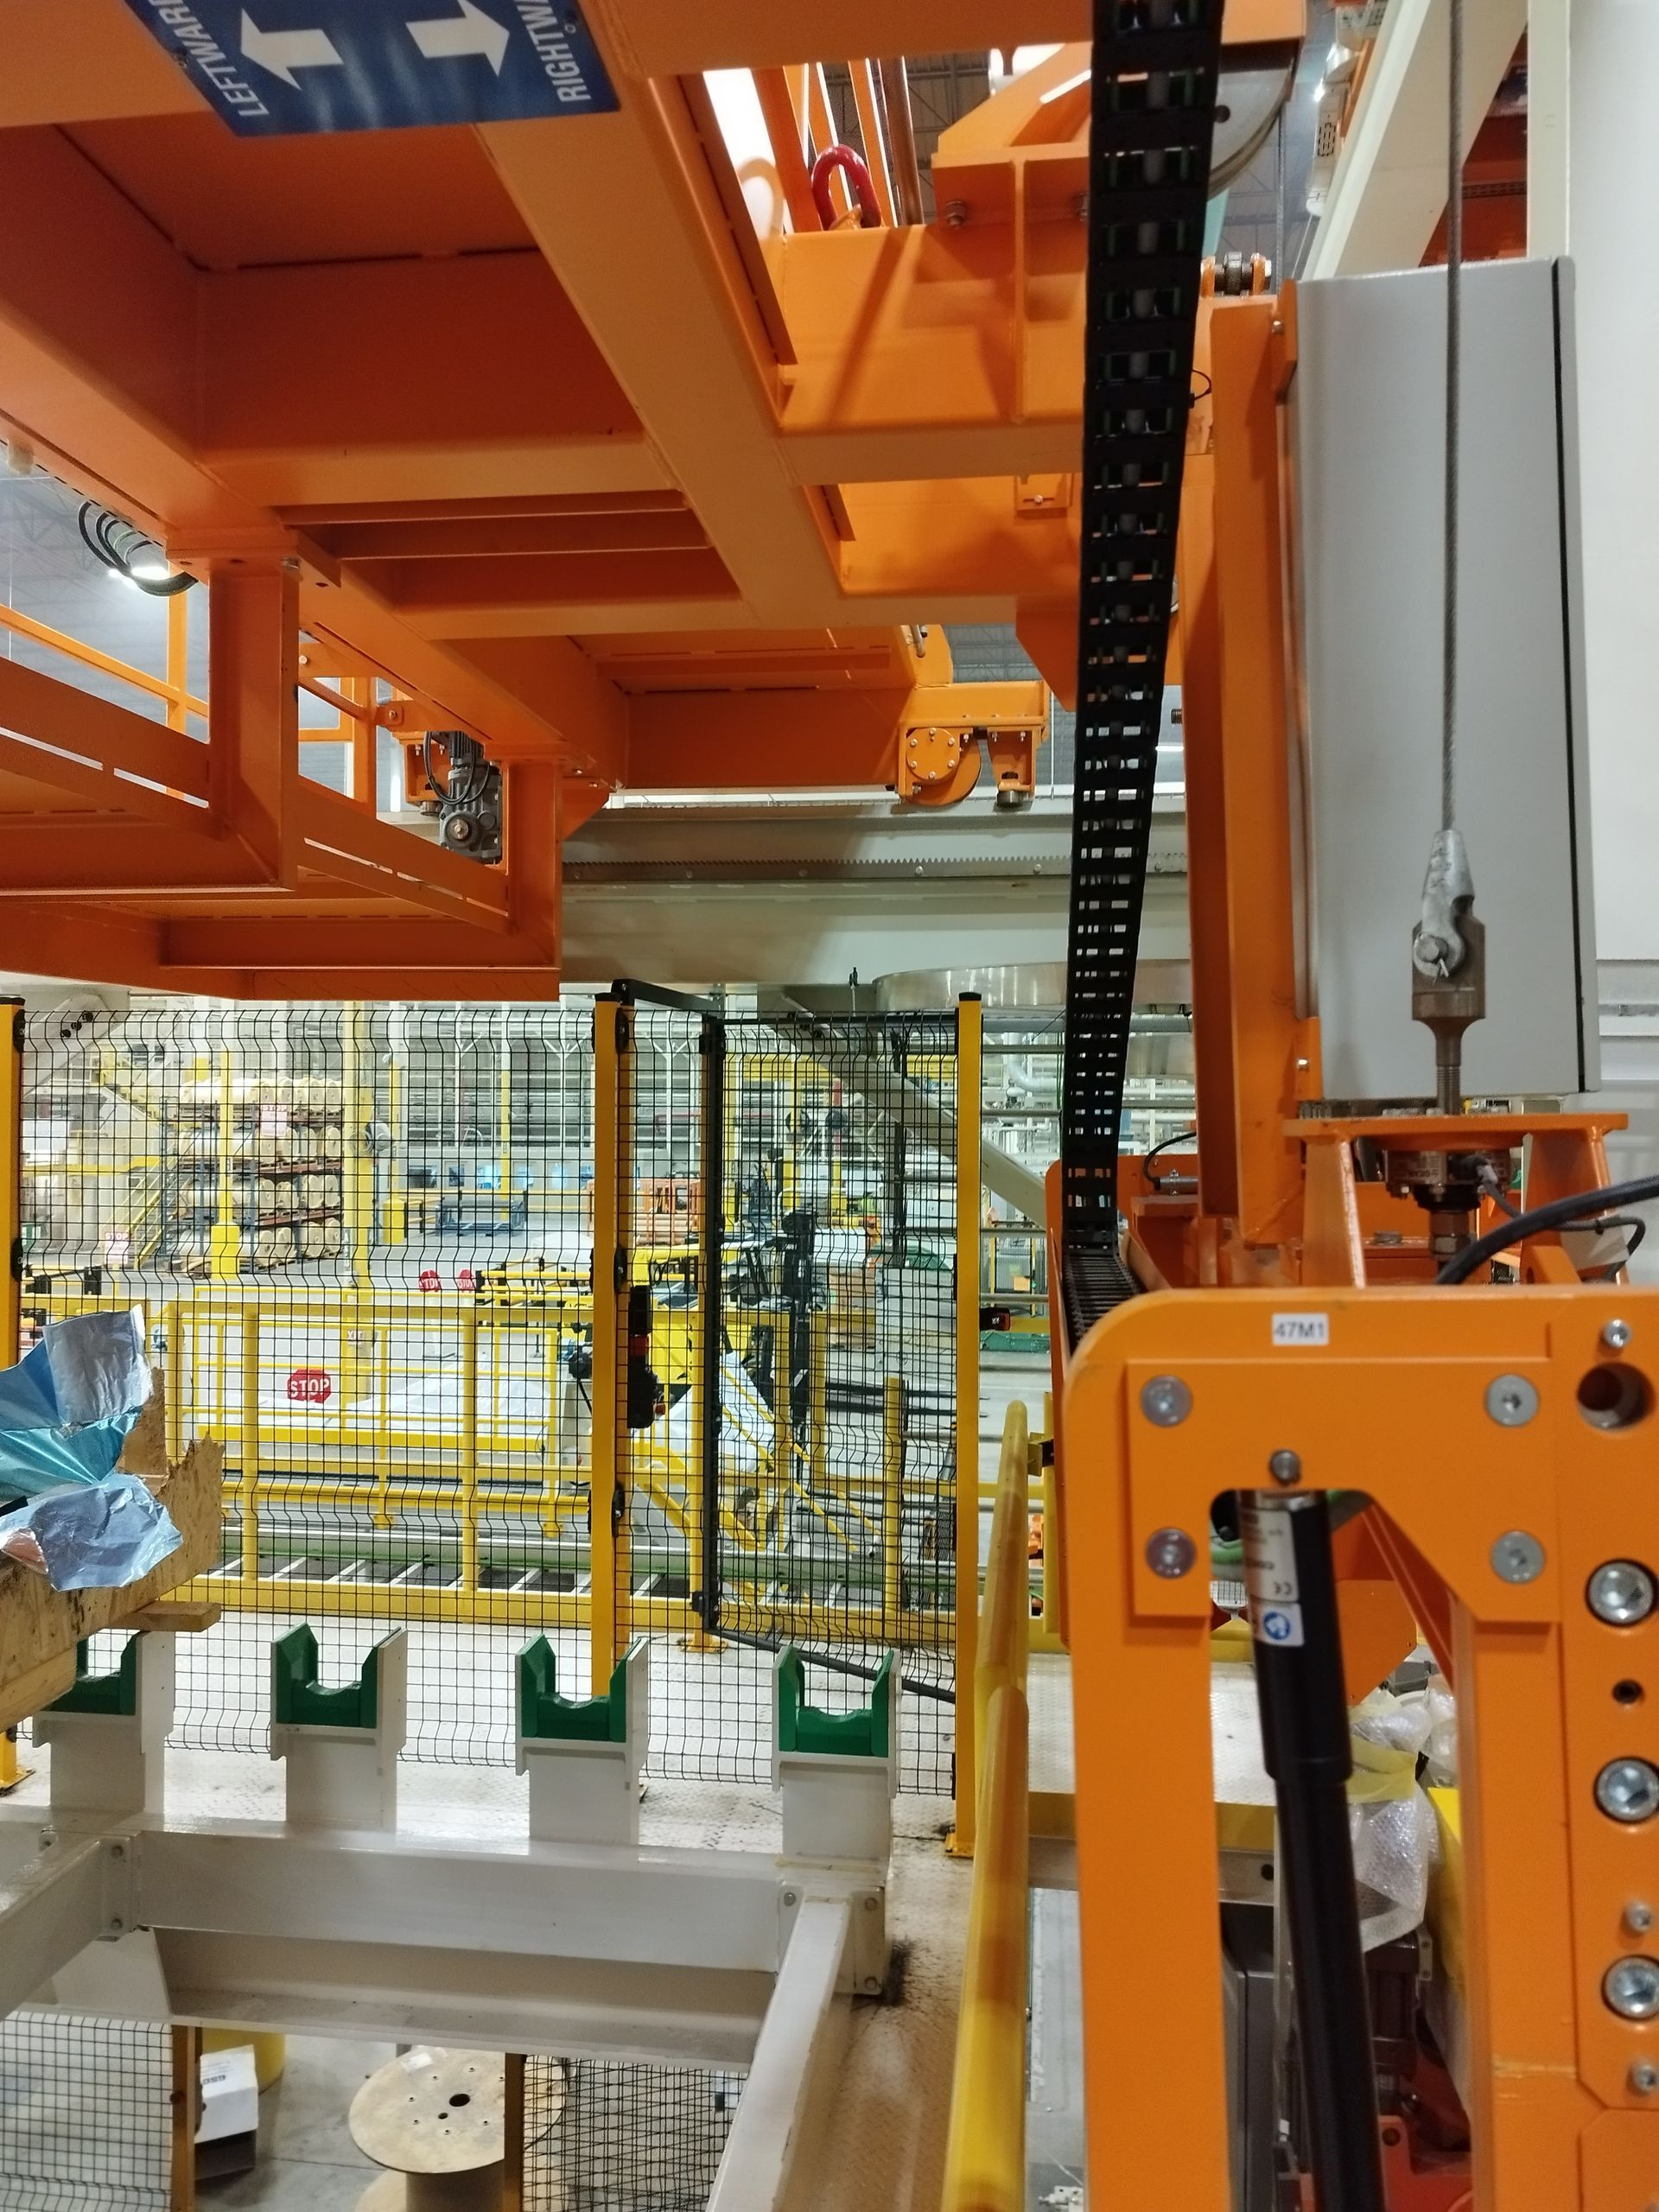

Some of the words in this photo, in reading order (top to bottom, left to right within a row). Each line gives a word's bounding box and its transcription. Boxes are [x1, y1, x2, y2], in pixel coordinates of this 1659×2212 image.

[514, 0, 592, 102] RIGHTW
[1274, 1322, 1325, 1338] 47M1
[289, 1377, 330, 1398] STOP
